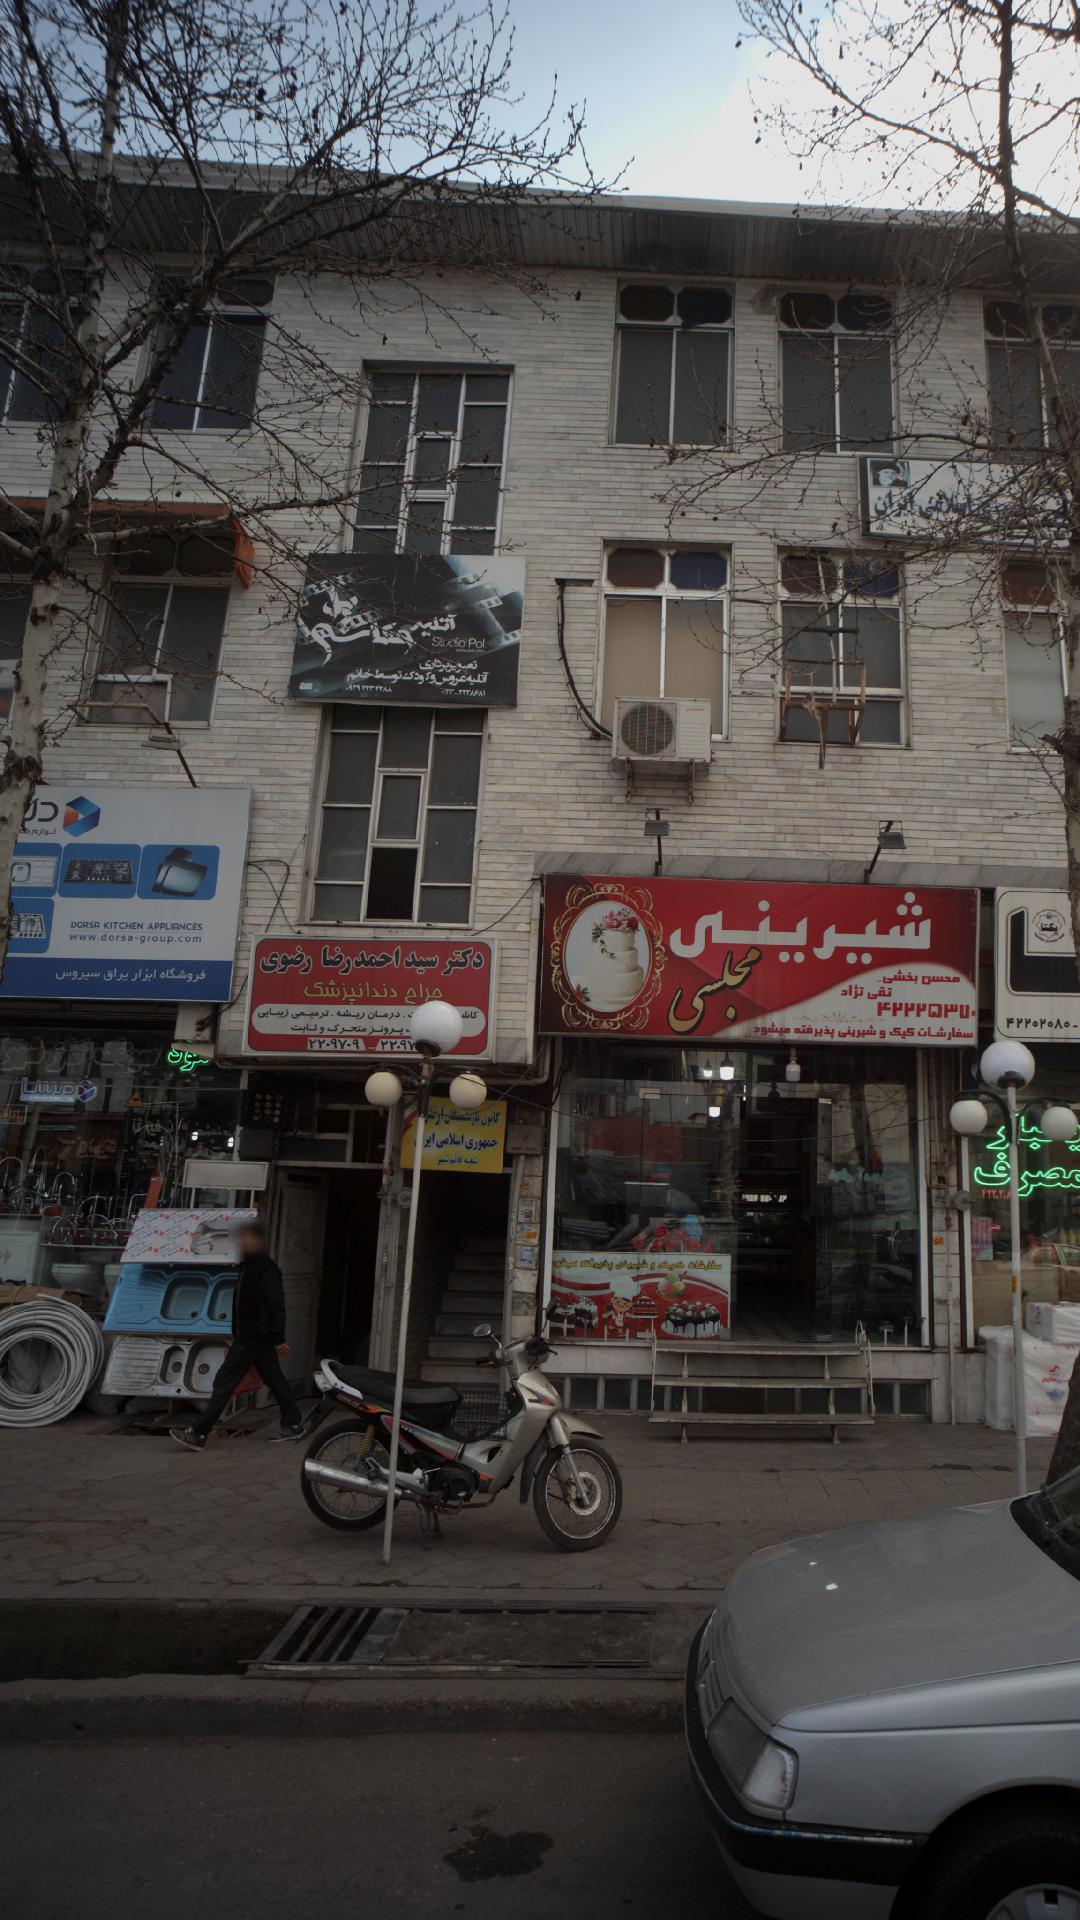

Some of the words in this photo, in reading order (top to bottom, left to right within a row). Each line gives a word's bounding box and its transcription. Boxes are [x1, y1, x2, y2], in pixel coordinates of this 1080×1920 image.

[431, 636, 466, 648] Studio
[468, 637, 486, 649] Pol
[71, 921, 101, 929] DORSA
[104, 921, 144, 930] KITCHEN
[148, 922, 203, 931] APPLIANCES
[669, 892, 931, 964] شیرینی
[260, 945, 313, 974] رضوی
[404, 951, 439, 974] سید
[441, 947, 484, 976] دکتر
[56, 970, 101, 982] سیروس
[103, 968, 129, 981] یراق
[131, 969, 157, 982] ابزار
[160, 968, 206, 982] فروشگاه
[882, 969, 918, 984] بخشی
[922, 975, 960, 985] محسن
[304, 979, 397, 1005] دندانپزشک
[667, 946, 762, 1035] مجلسی
[258, 1008, 289, 1018] زیبایی
[291, 1010, 329, 1019] ترمیمی
[337, 1010, 365, 1019] ریشه
[368, 1009, 400, 1019] درمان
[877, 1002, 976, 1019] ۴۲۲۲۵۳۷۰
[327, 1025, 367, 1034] متحرک
[753, 1022, 790, 1036] میشود
[794, 1024, 834, 1039] پذیرفته
[838, 1024, 876, 1039] شیرینی
[879, 1030, 886, 1039] و
[890, 1027, 915, 1039] کیک
[917, 1027, 973, 1040] سفارشات
[309, 1039, 360, 1049] ۲۲۰۹۷۰۹
[381, 1040, 416, 1050] ۲۲۰۹۷
[436, 1131, 464, 1148] اسلامی
[465, 1137, 497, 1150] جمهوری
